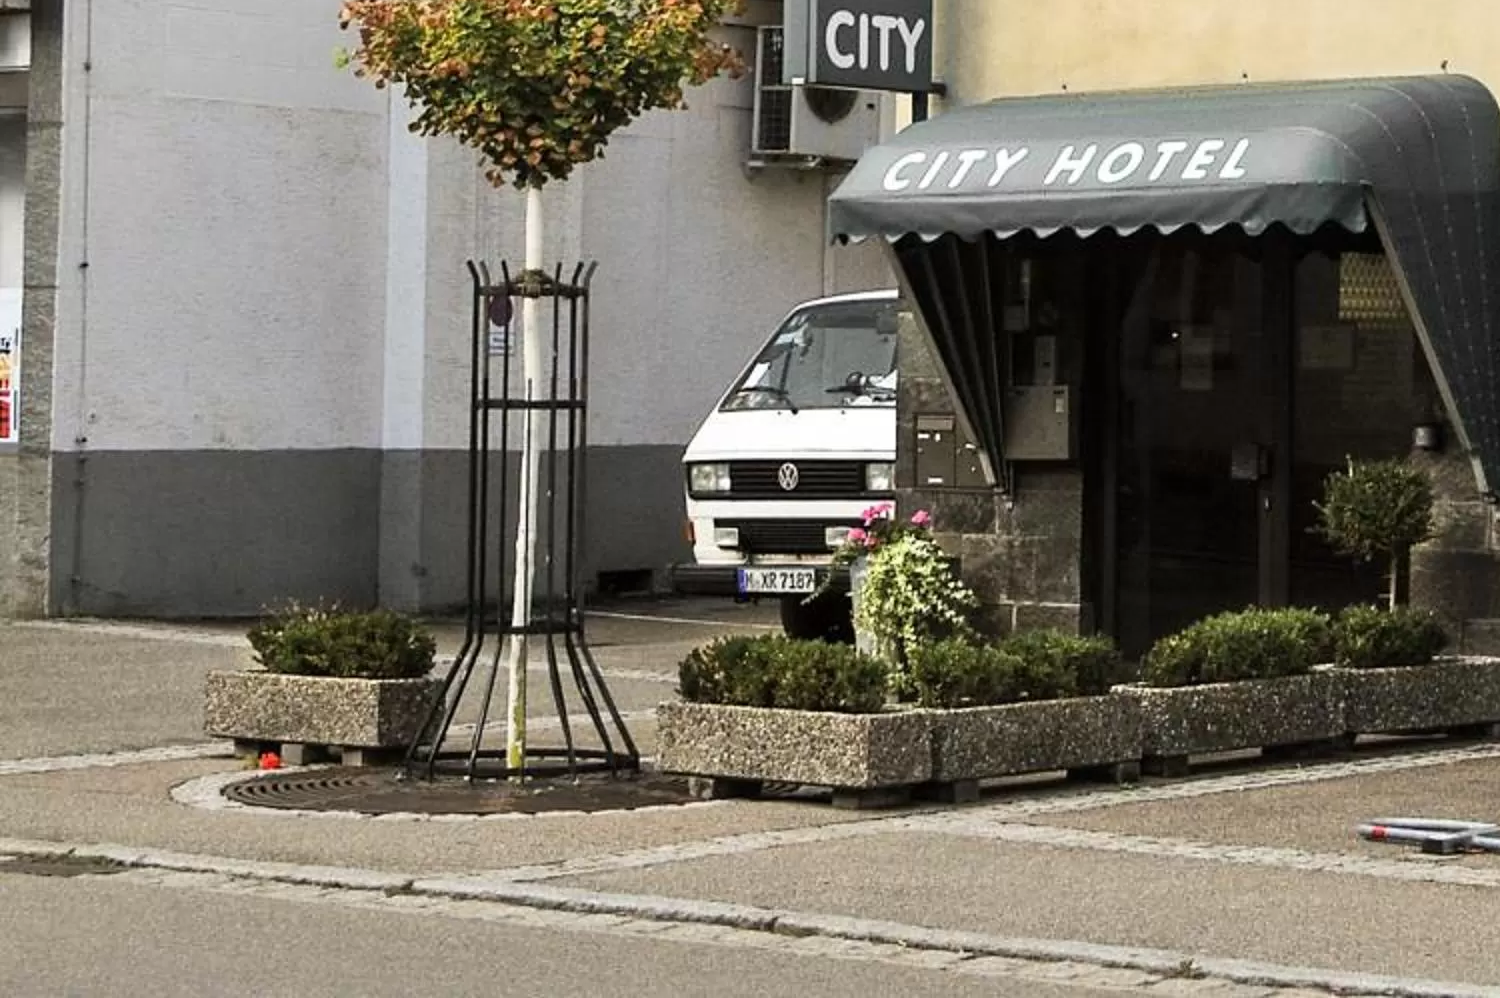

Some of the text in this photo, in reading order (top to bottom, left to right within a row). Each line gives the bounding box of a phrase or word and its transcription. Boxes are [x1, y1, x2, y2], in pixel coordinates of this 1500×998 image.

[825, 10, 925, 73] CITY
[882, 137, 1251, 191] CITY HOTEL
